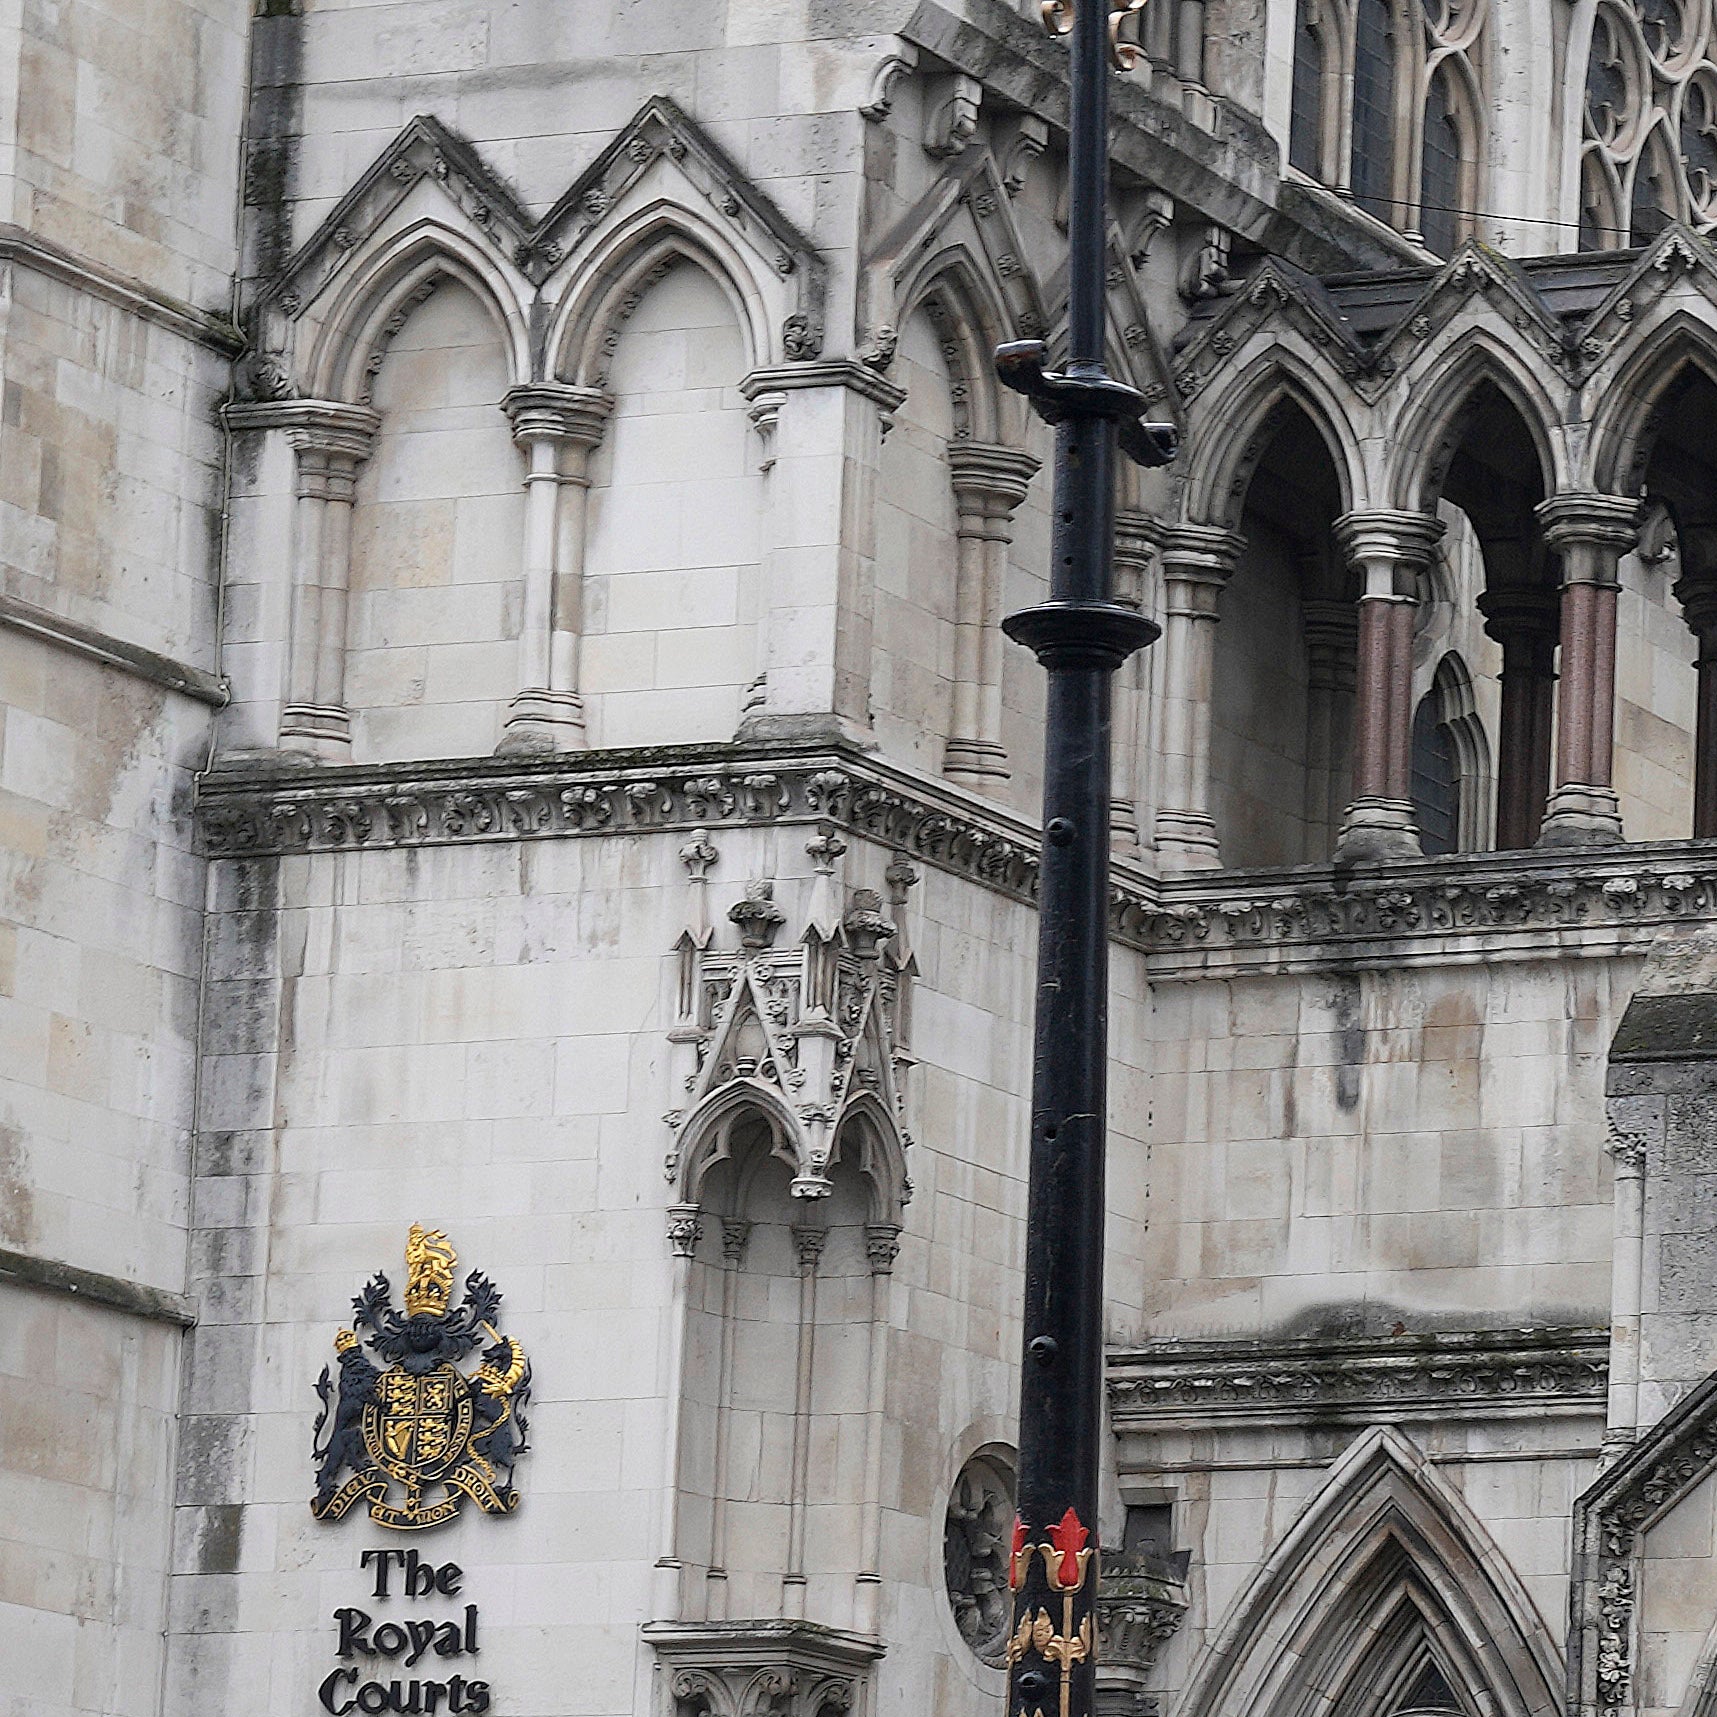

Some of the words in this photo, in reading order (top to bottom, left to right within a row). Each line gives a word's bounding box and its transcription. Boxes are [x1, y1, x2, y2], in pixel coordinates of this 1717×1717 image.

[454, 1467, 496, 1509] DROIT
[361, 1549, 463, 1599] The
[334, 1605, 480, 1667] Royal
[318, 1668, 490, 1717] Courts
